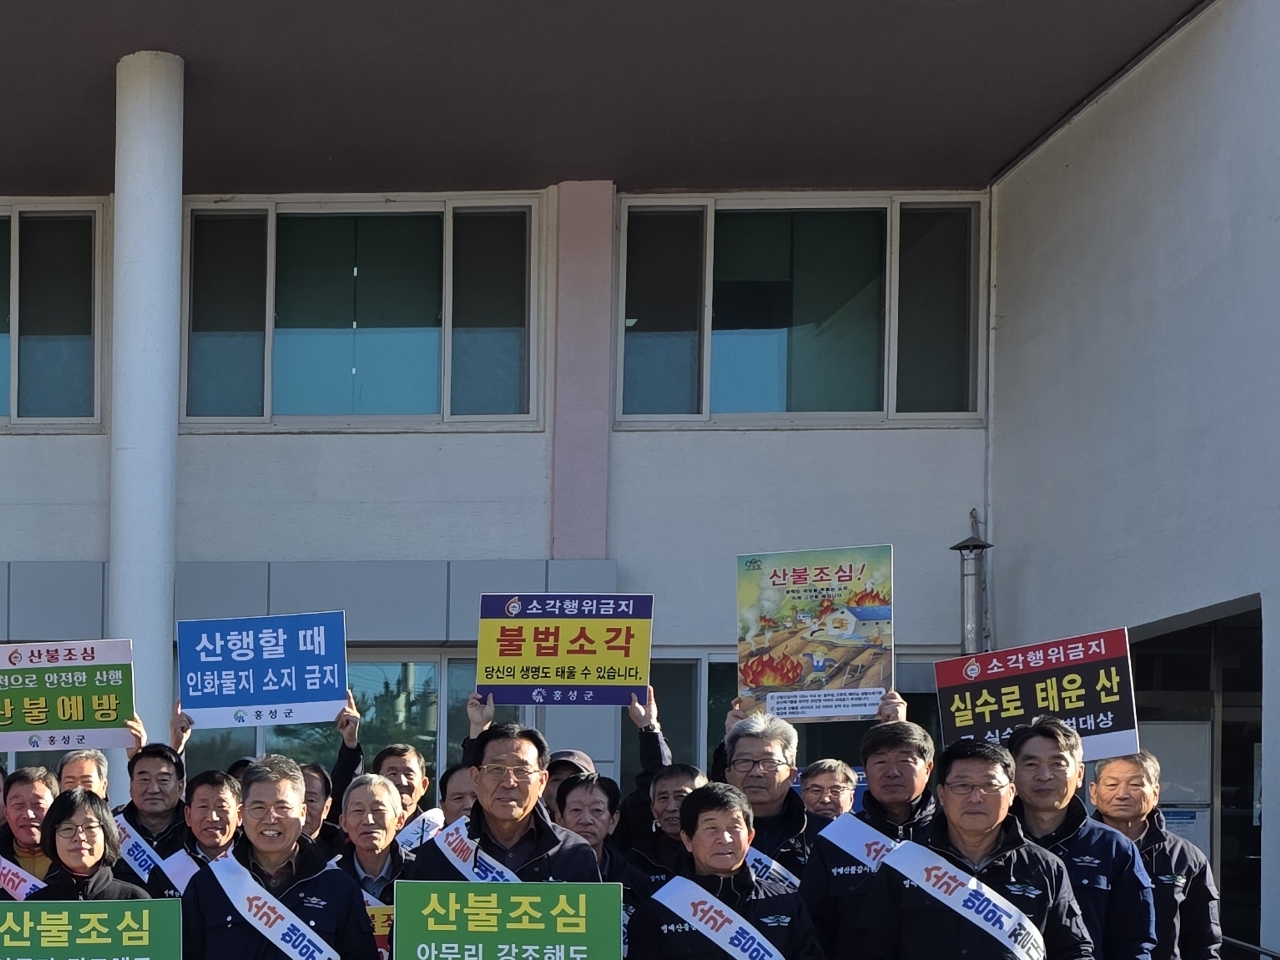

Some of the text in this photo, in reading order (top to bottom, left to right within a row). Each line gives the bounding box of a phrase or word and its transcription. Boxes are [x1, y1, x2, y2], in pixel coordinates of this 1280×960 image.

[769, 563, 866, 586] 산불조심!
[526, 599, 634, 615] 소각행위금지
[27, 646, 96, 664] 산불조심
[195, 625, 326, 662] 산행할 때
[496, 625, 635, 658] 불법소각
[986, 638, 1106, 674] 소각행위금지
[45, 671, 87, 688] 안전한
[94, 670, 123, 686] 산행
[186, 663, 339, 696] 인화물지 소지 금지
[484, 665, 642, 681] 당신의 생명도 태울 수 있습니다.
[552, 690, 594, 701] 홍성군
[950, 666, 1120, 728] 실수로 태운 산
[253, 708, 294, 720] 홍성군
[47, 735, 86, 746] 홍성군
[246, 895, 286, 929] 소각
[421, 892, 587, 934] 산불조심
[923, 865, 967, 896] 소각
[962, 889, 1013, 931] 행위
[690, 900, 734, 933] 소각
